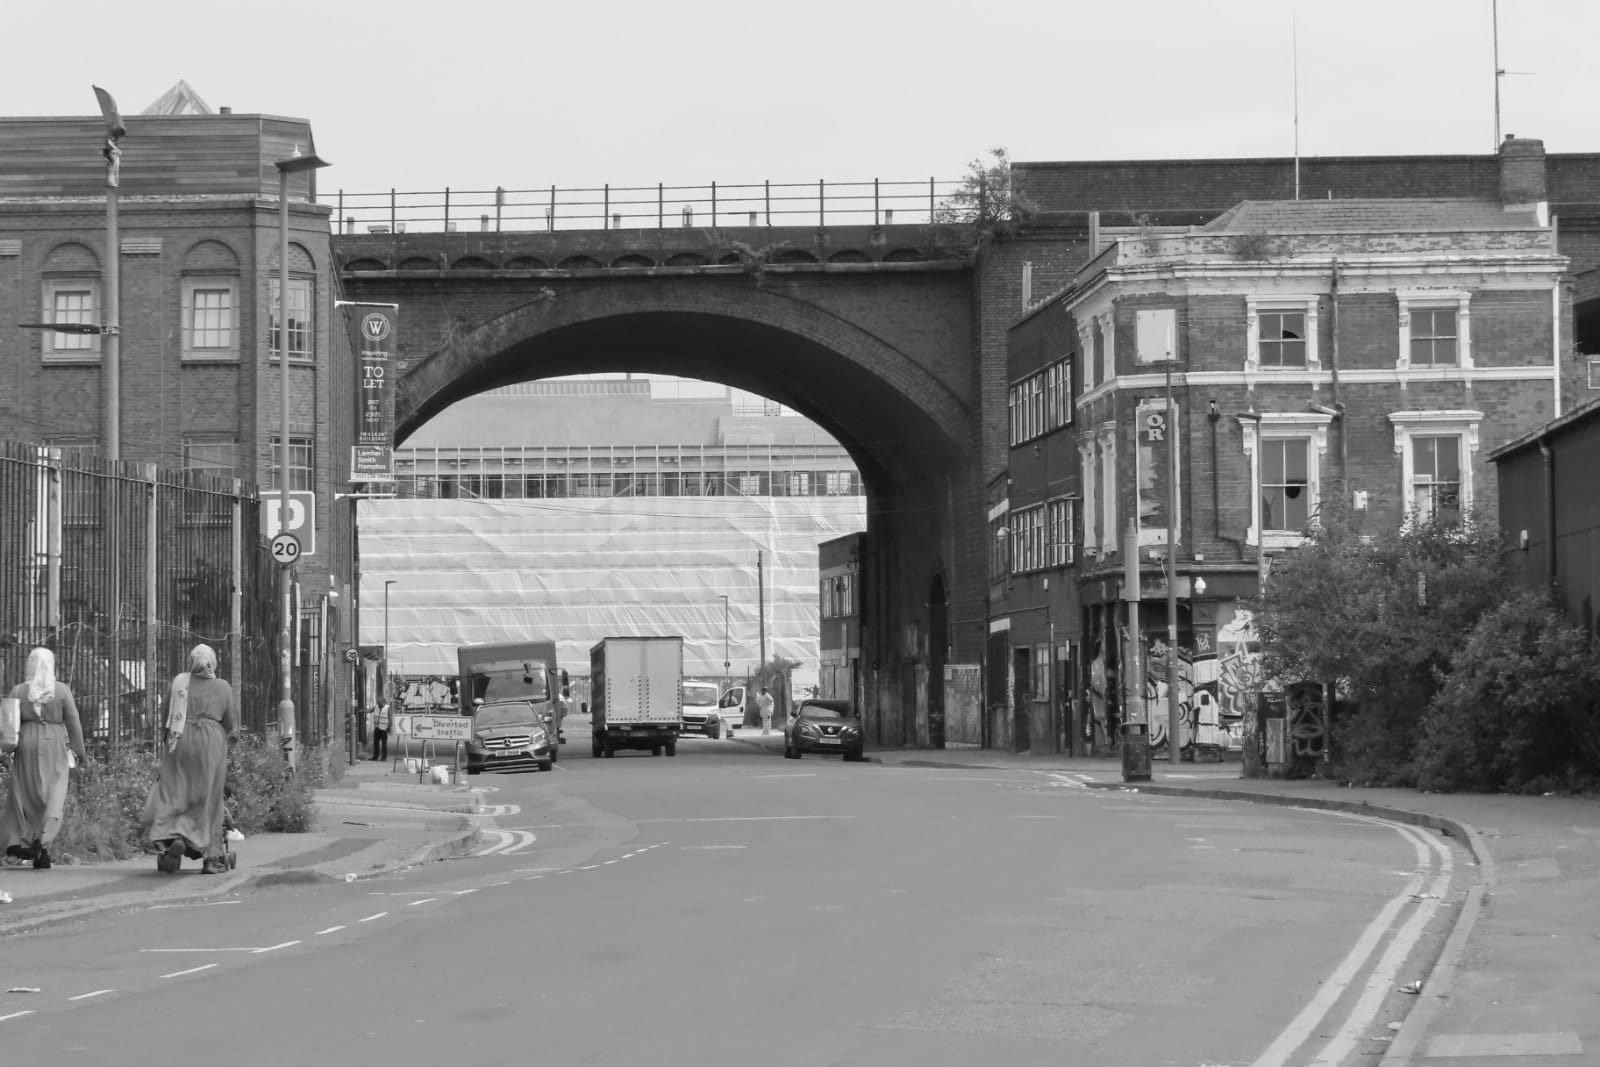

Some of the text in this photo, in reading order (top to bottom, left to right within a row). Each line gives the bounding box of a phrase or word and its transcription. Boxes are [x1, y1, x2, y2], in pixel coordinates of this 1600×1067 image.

[369, 320, 383, 336] W
[363, 366, 384, 378] TO
[363, 379, 384, 389] LET
[357, 449, 385, 457] Lambert
[357, 463, 386, 471] Hampton
[274, 542, 297, 556] 20
[433, 719, 469, 728] Diverted
[437, 728, 465, 737] traffic
